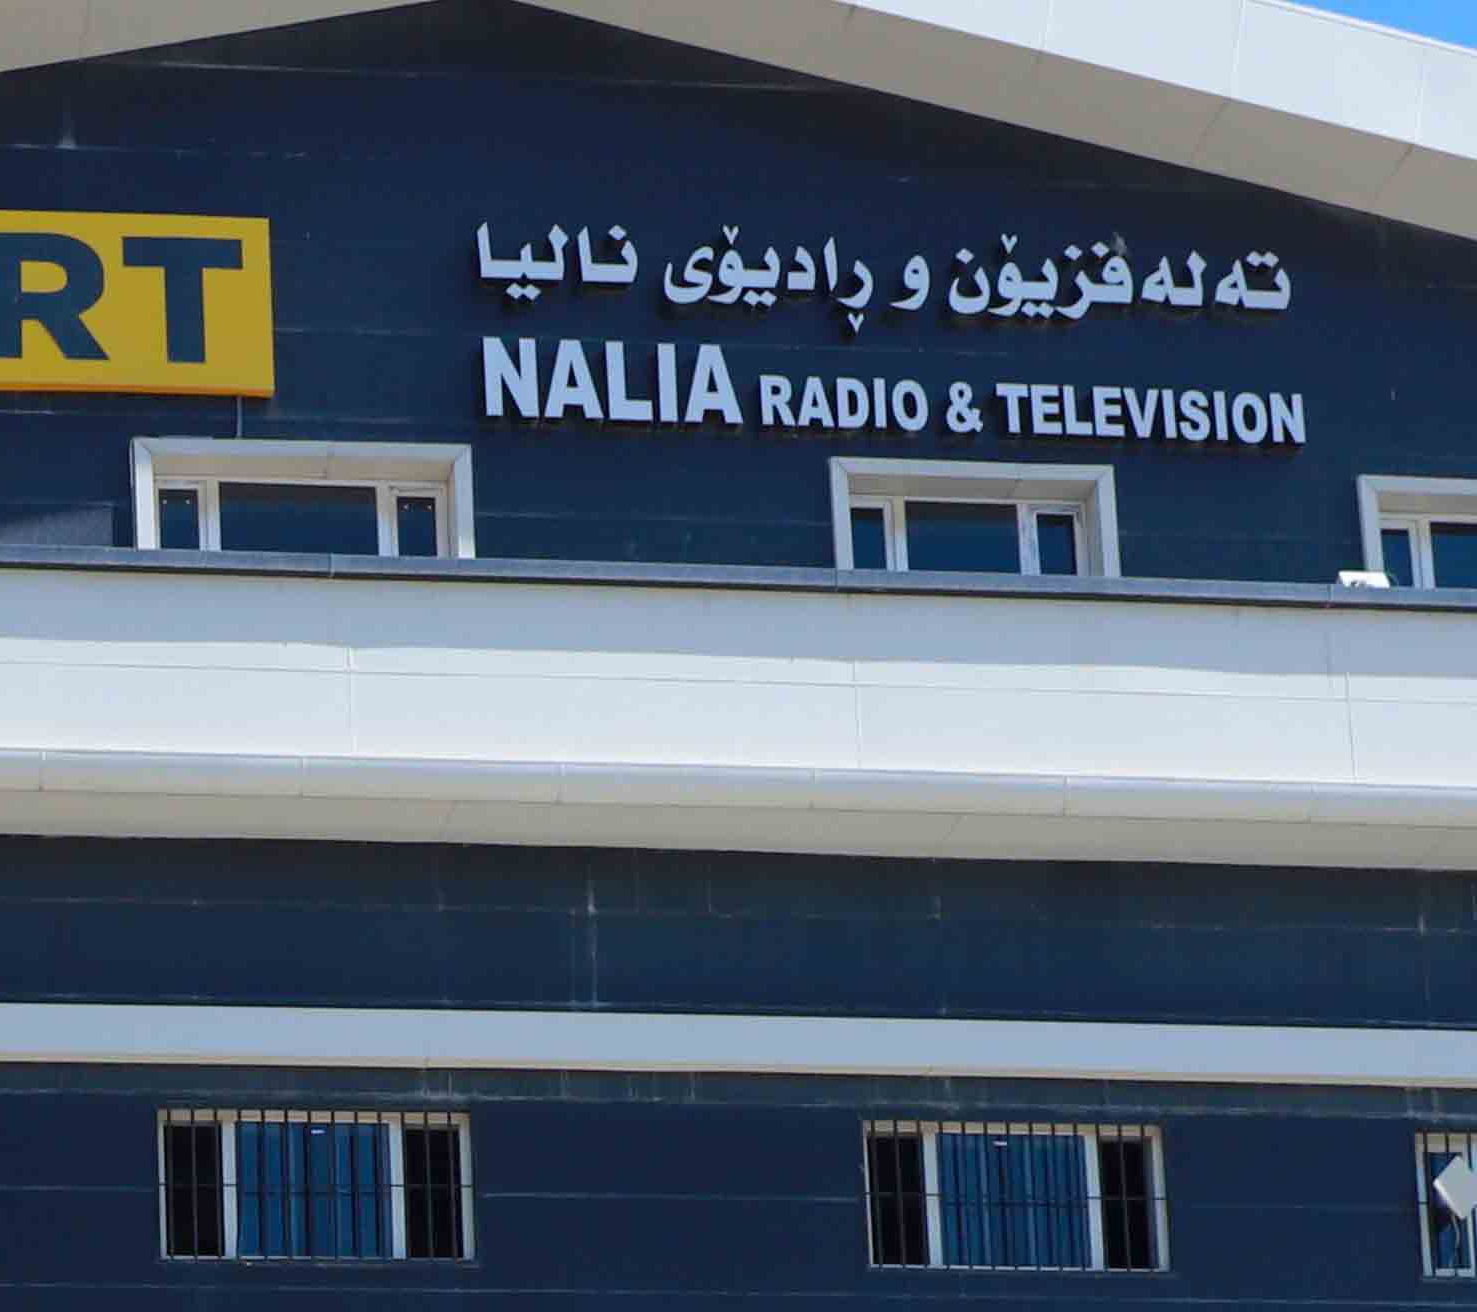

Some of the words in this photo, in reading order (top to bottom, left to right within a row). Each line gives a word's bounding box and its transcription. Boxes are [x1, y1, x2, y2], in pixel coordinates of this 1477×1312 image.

[890, 255, 930, 310] و
[483, 336, 744, 424] NALIA
[760, 375, 928, 431] RADIO
[946, 381, 984, 433] &
[996, 383, 1306, 443] TELEVISION
